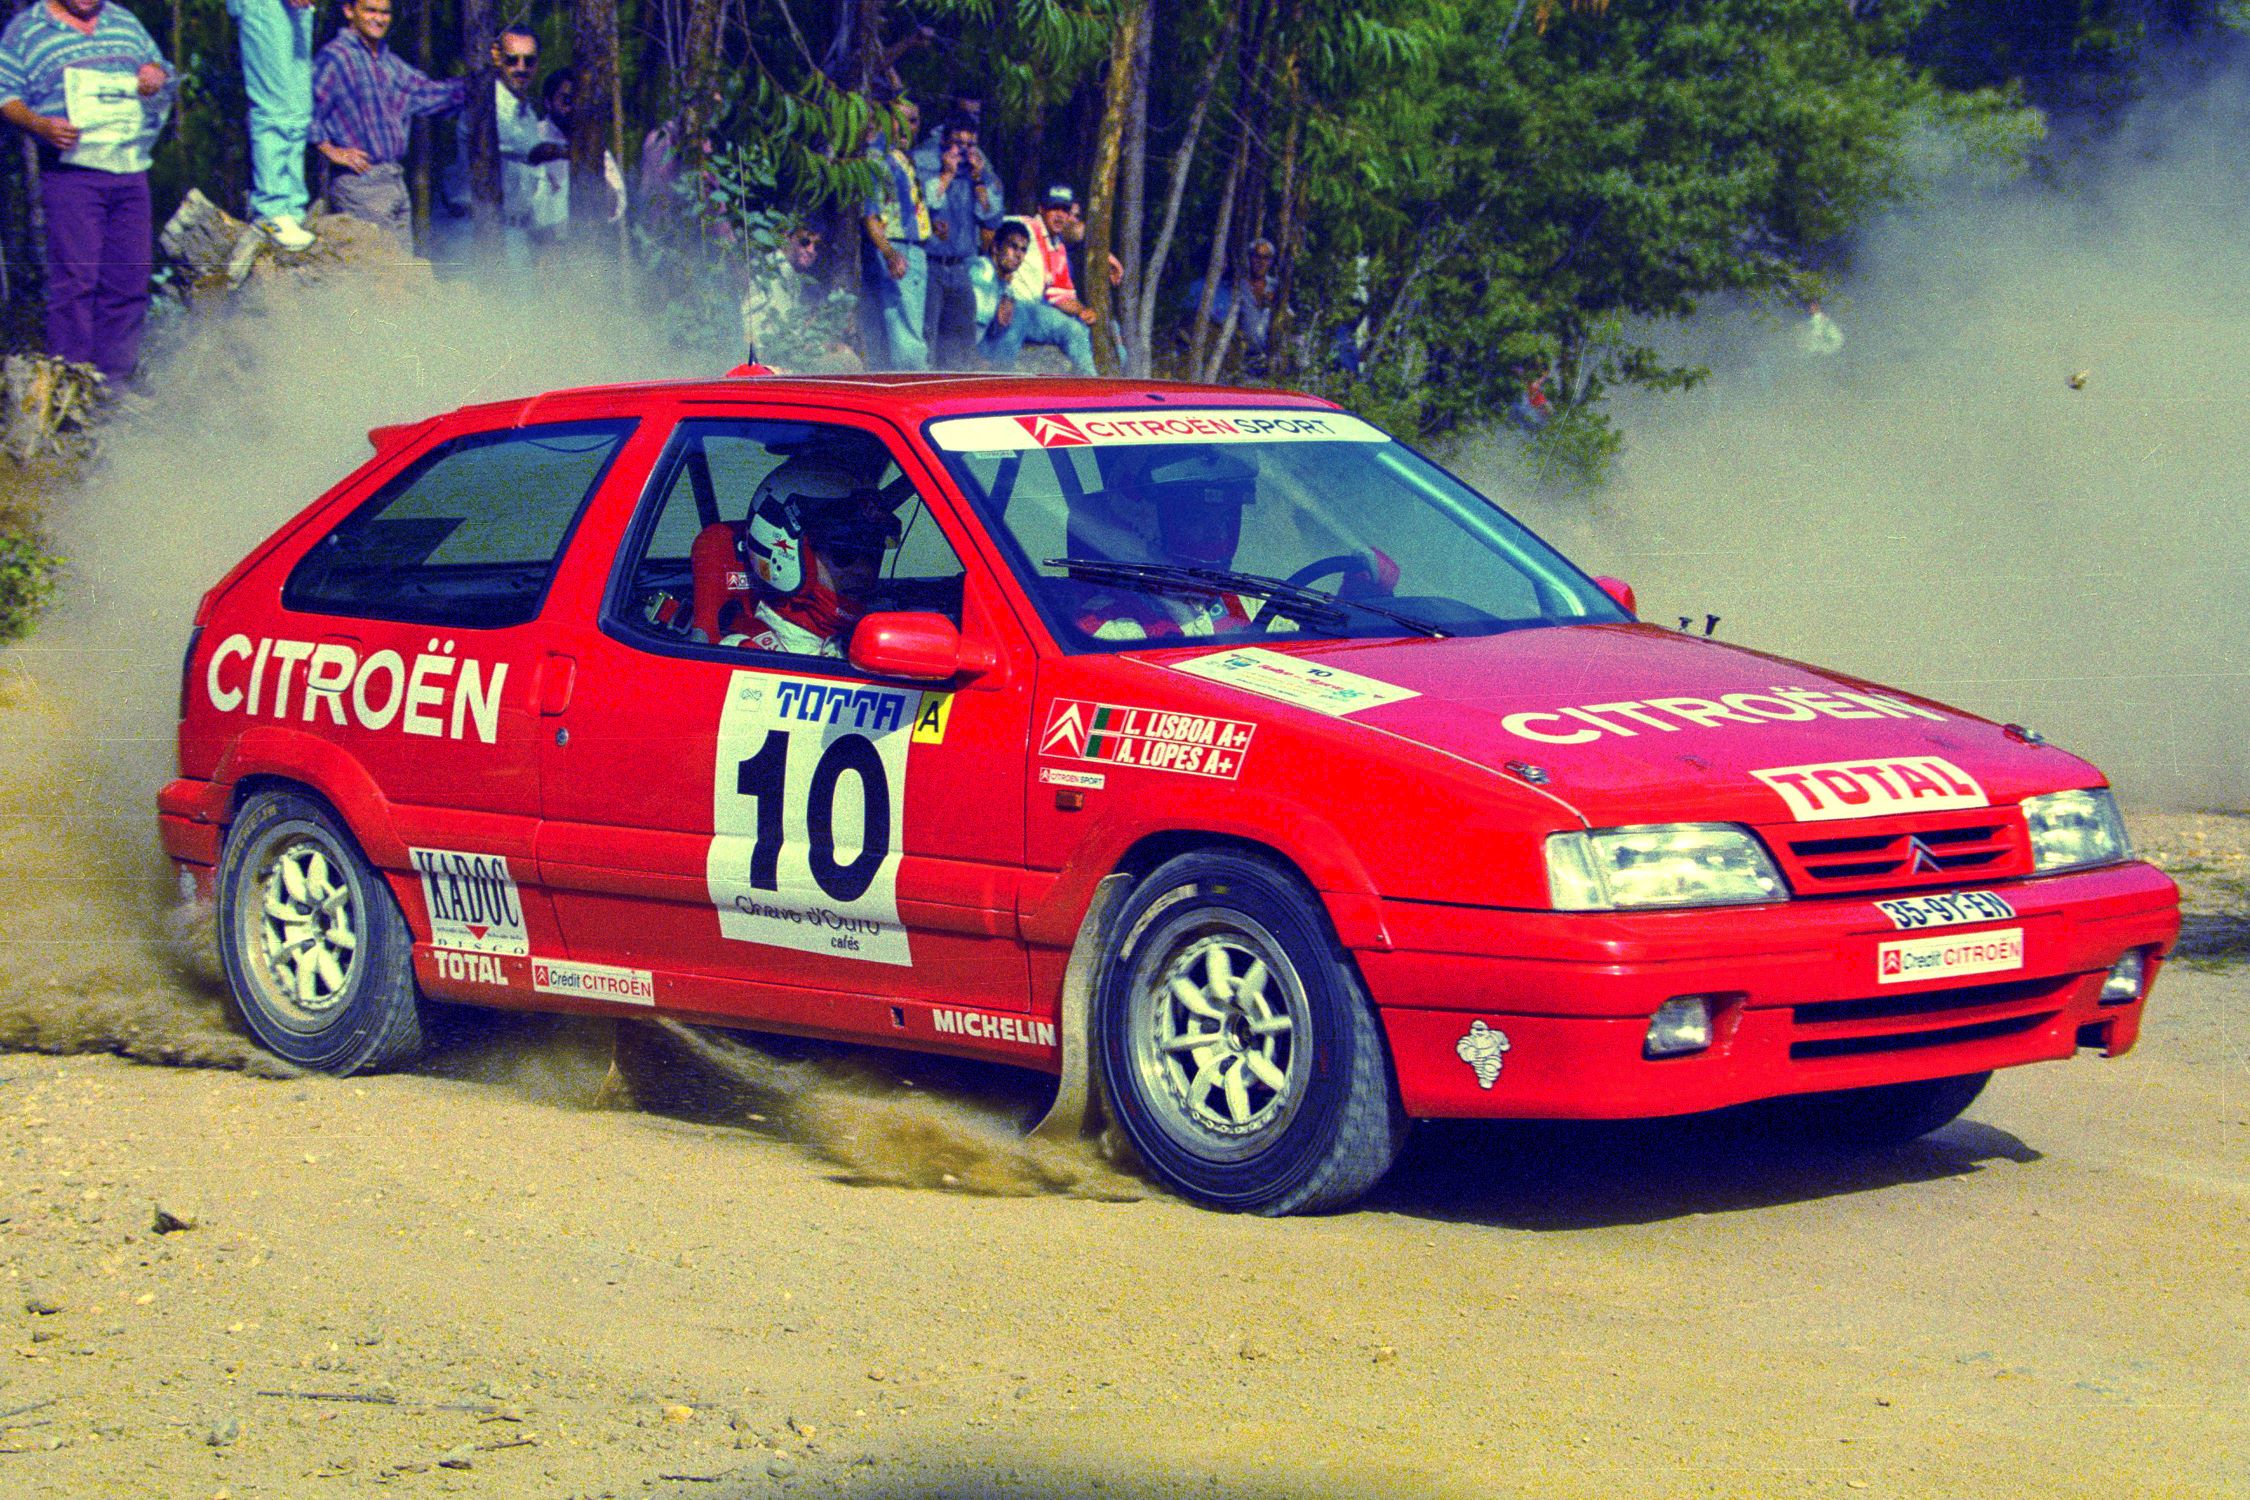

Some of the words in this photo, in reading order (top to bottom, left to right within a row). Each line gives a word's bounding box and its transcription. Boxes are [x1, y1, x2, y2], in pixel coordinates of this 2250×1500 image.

[206, 633, 509, 744] CITROËN
[776, 680, 907, 731] TOTTA
[917, 700, 940, 733] A
[1123, 710, 1141, 735] L.
[1146, 713, 1217, 746] LISBOA
[1215, 724, 1248, 748] A+
[1501, 685, 1949, 745] CITROËN
[1116, 738, 1136, 764] A.
[1139, 741, 1203, 773] LOPES
[1202, 750, 1234, 774] A+
[1768, 761, 1978, 812] TOTAL
[736, 729, 891, 903] 10
[416, 851, 520, 928] KADOC
[433, 950, 509, 986] TOTAL
[1943, 937, 2021, 966] CITROËN
[582, 973, 652, 998] CITROËN
[932, 1008, 1057, 1047] MICHELIN
